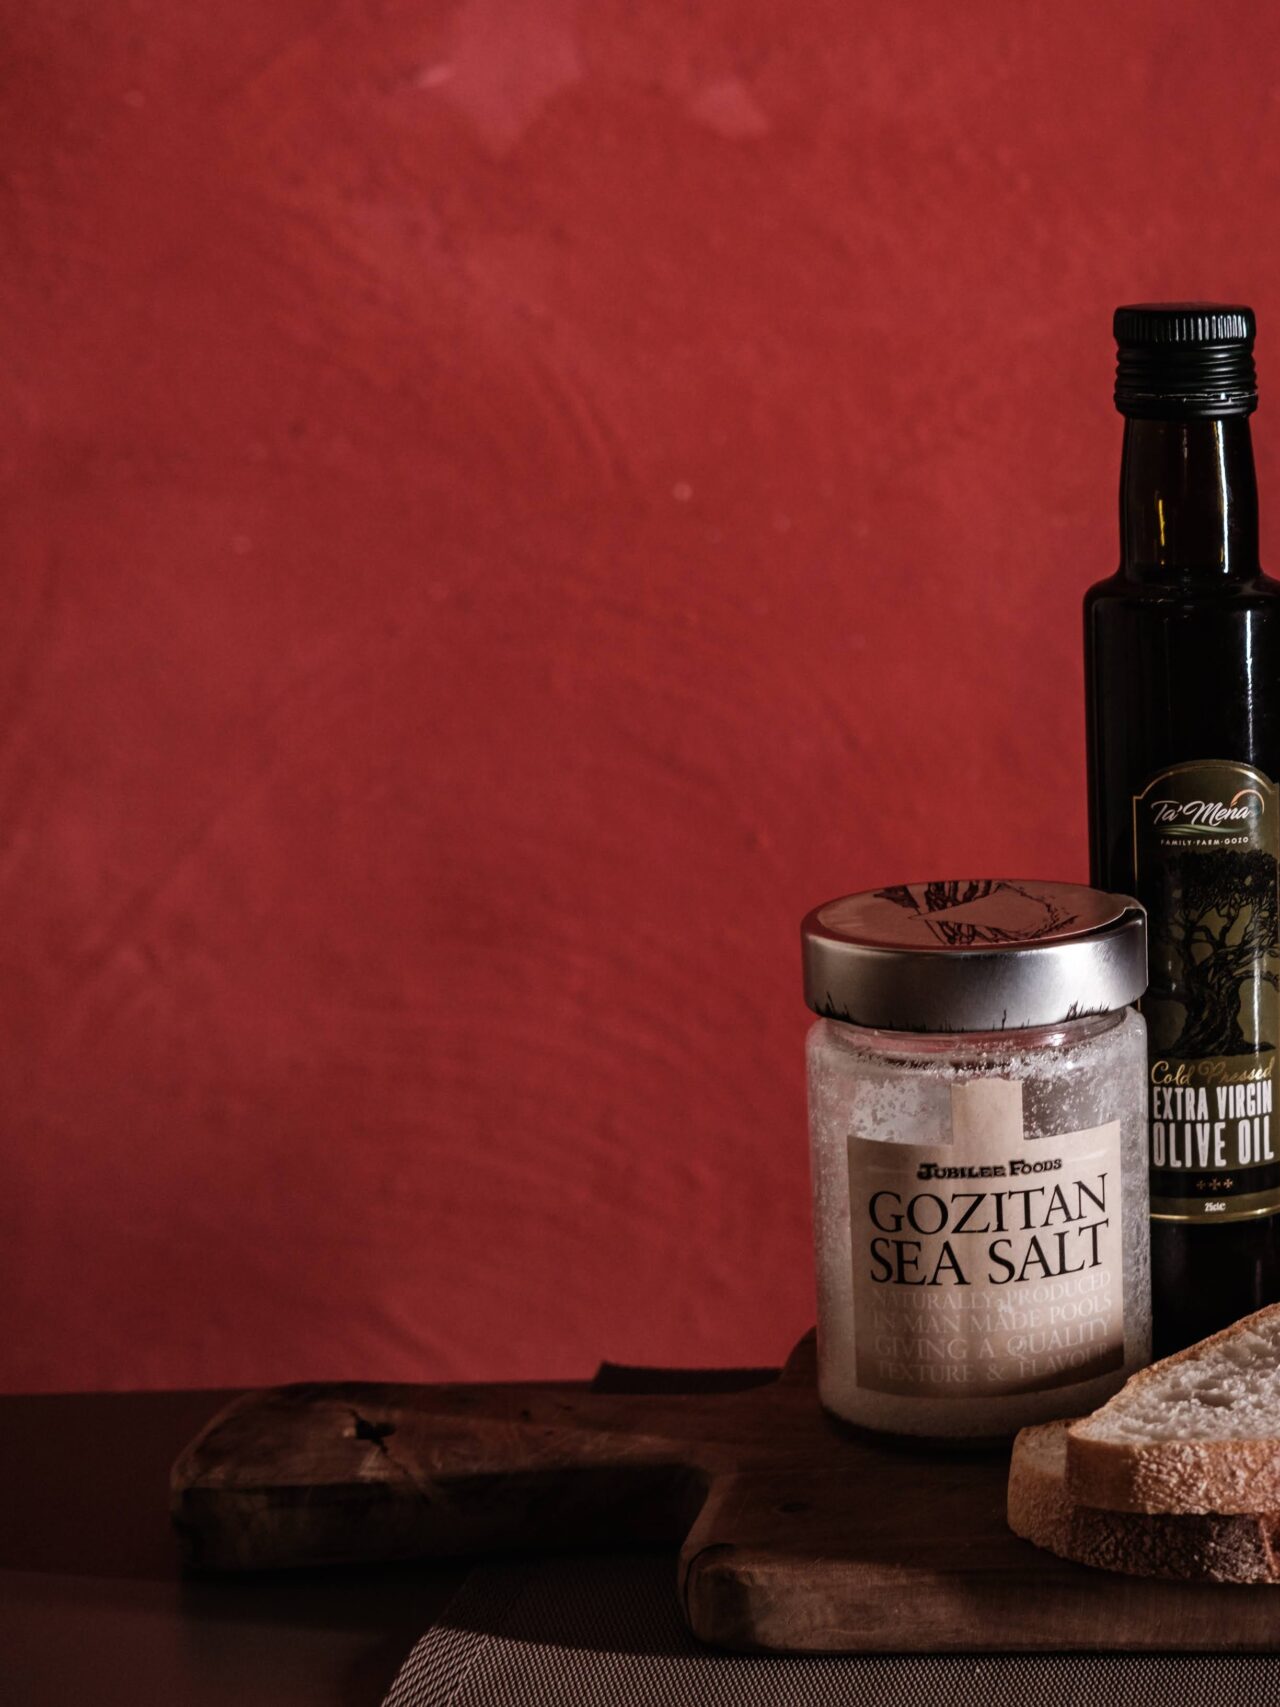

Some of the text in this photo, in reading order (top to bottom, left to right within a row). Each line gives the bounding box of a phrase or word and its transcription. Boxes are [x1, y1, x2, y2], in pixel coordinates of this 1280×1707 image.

[1151, 1056, 1275, 1085] Cold Pressed
[1153, 1079, 1272, 1120] EXTRA VIRGIN
[1153, 1115, 1274, 1168] OLIVE OIL
[868, 1173, 1108, 1235] GOZITAN
[869, 1219, 1109, 1286] SEA SALT
[871, 1271, 1111, 1311] NATURALLY PRODUCED
[873, 1293, 1112, 1333] IN MAN MADE POOLS
[875, 1316, 1111, 1361] GIVING A QUALITY
[879, 1360, 975, 1383] TEXTURE
[986, 1364, 1008, 1382] &
